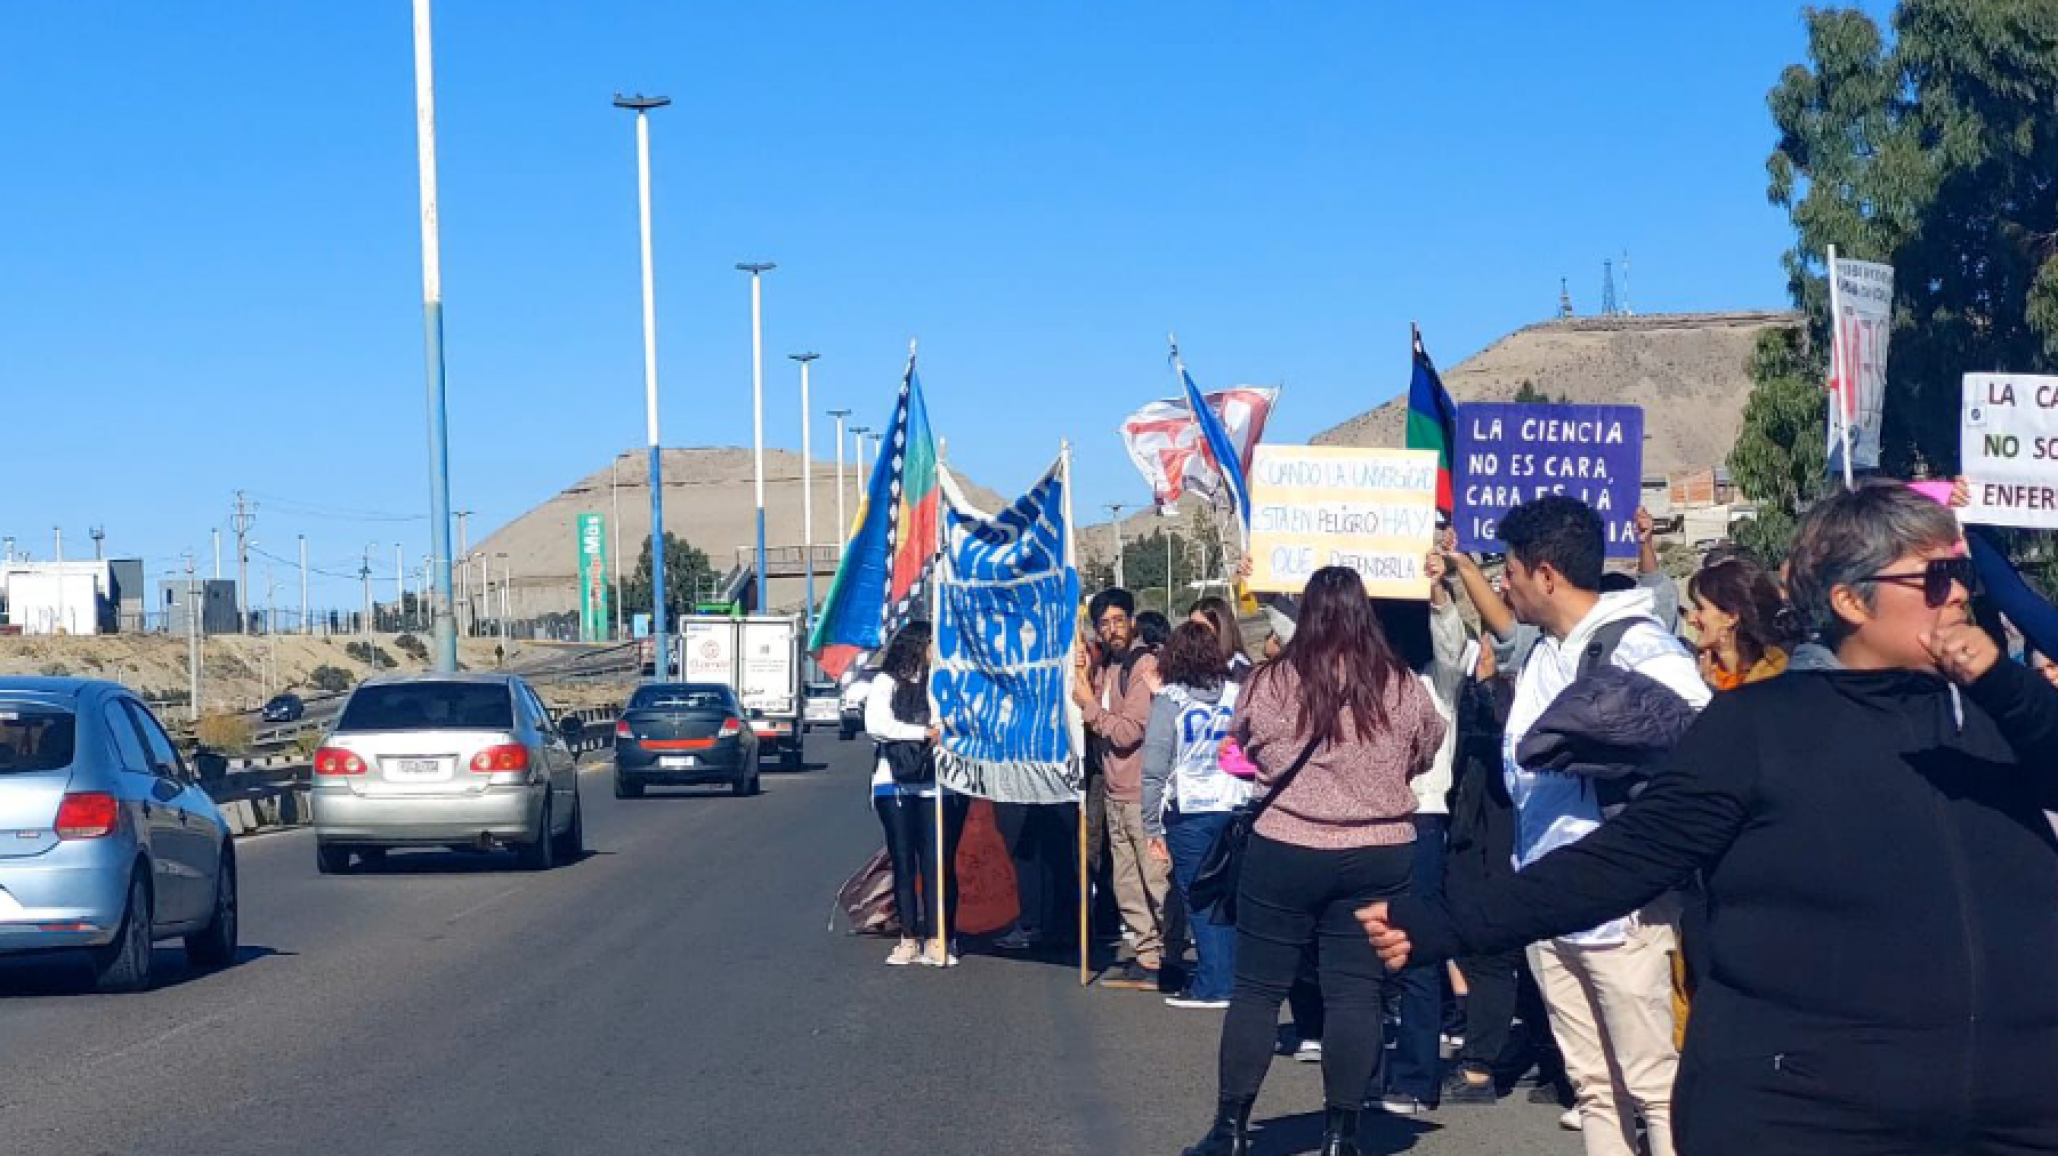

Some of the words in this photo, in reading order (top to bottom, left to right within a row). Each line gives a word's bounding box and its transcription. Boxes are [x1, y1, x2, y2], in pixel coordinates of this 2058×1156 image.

[1988, 383, 2016, 407] LA
[1473, 417, 1502, 441] LA
[1521, 418, 1623, 443] CIENCIA
[1984, 434, 2020, 459] NO
[1259, 458, 1321, 487] CUANDO
[1326, 461, 1347, 486] LA
[1468, 453, 1498, 476] NO
[1510, 454, 1535, 476] ES
[1544, 456, 1614, 485] CARA,
[1466, 484, 1522, 507] CARA
[1582, 488, 1612, 510] LA
[1983, 483, 2058, 510] ENFER
[1272, 547, 1313, 574] QUE
